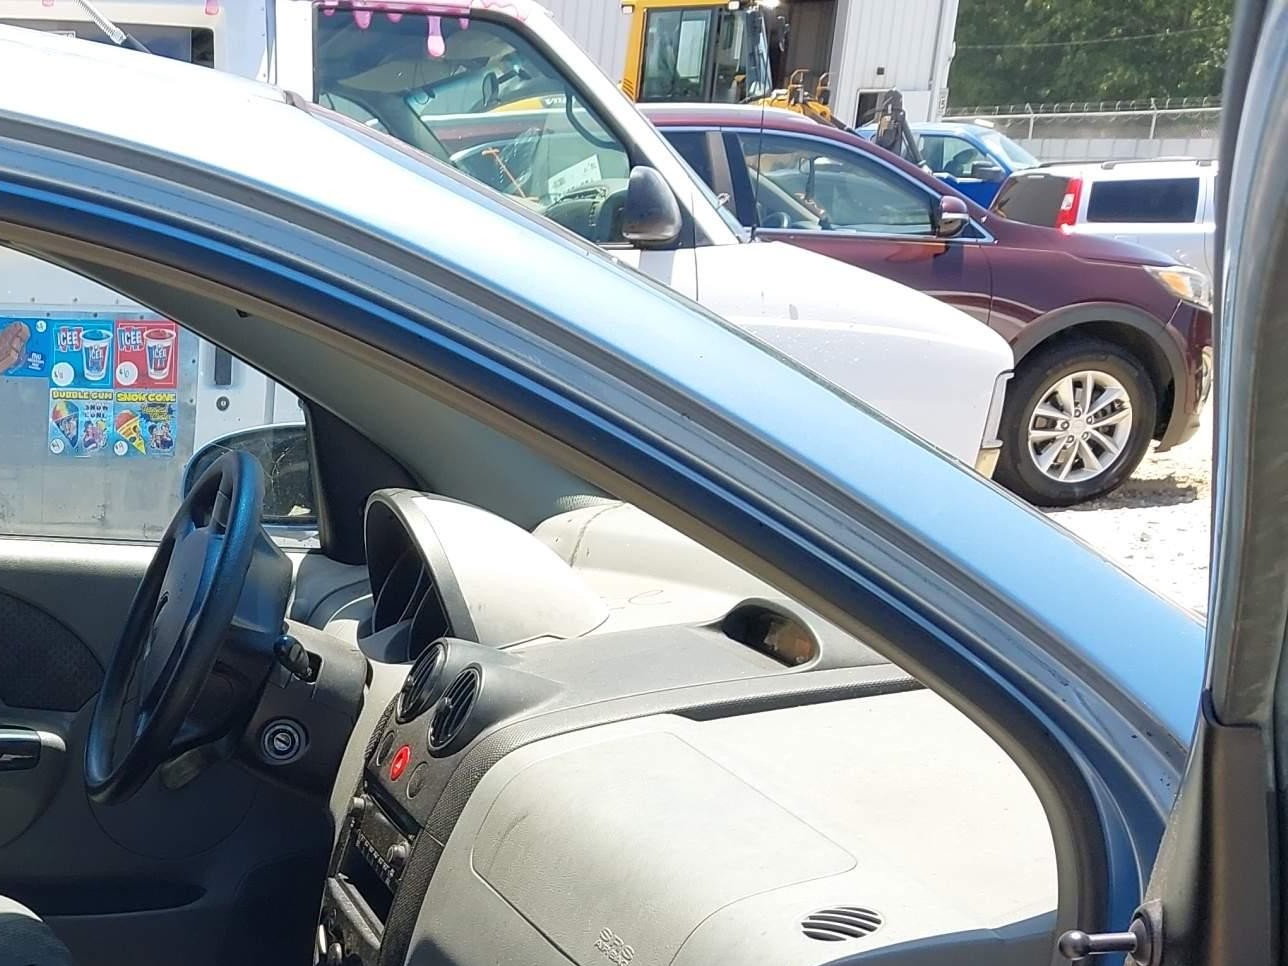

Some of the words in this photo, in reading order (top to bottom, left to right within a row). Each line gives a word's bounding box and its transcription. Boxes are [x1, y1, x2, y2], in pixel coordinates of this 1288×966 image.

[57, 331, 79, 345] ICEE
[120, 330, 143, 344] ICEE
[116, 392, 145, 402] SNOW
[146, 393, 177, 402] CONE
